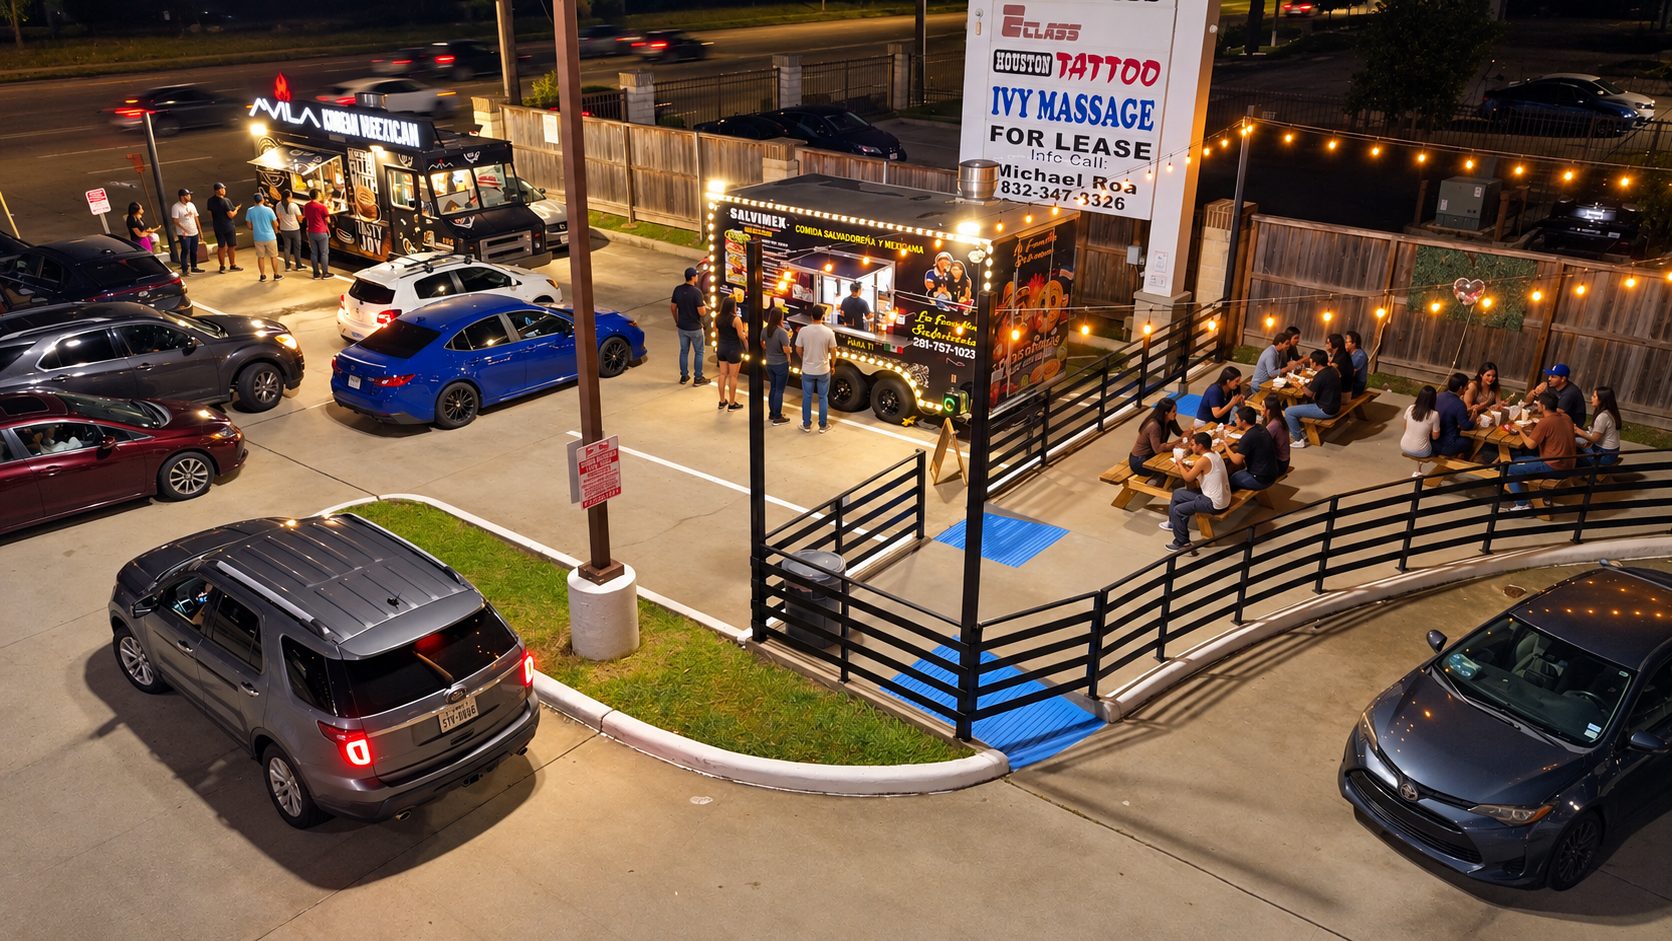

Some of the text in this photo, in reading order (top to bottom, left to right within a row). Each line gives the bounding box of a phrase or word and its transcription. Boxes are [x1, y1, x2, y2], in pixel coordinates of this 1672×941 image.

[995, 51, 1161, 87] HOUSTON TATTOO
[991, 86, 1155, 131] IVY MASSAGE
[990, 125, 1152, 161] FOR LEASE
[998, 164, 1137, 195] Michael Roa
[356, 219, 382, 240] TASTY
[730, 207, 786, 230] SALVIMEX
[360, 234, 382, 256] JOY
[795, 224, 823, 238] COMIDA
[878, 239, 884, 247] Y
[913, 336, 976, 360] 281-757-1023
